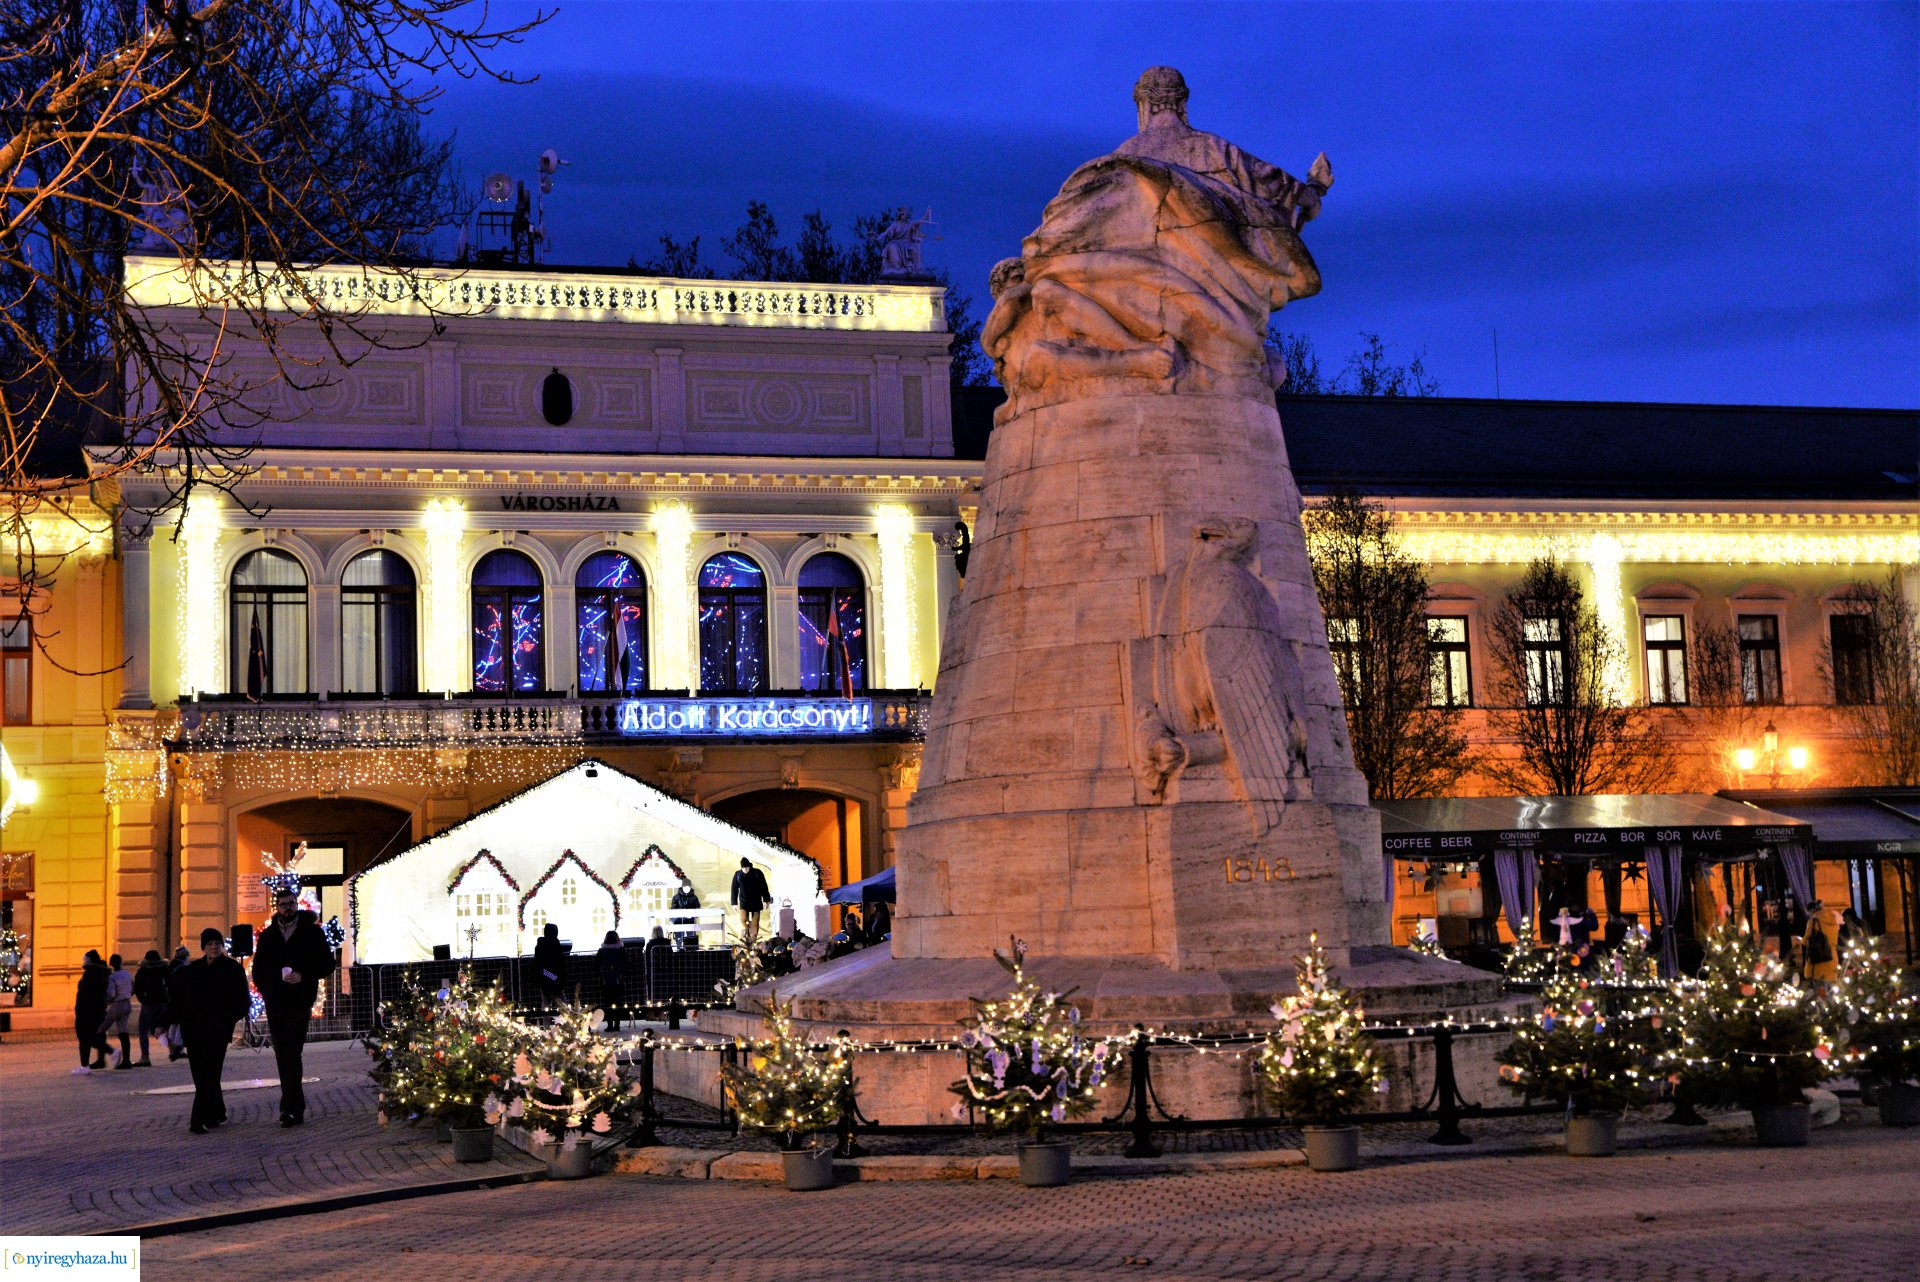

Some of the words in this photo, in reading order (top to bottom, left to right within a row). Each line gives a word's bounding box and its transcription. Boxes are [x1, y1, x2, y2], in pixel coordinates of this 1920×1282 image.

[501, 491, 620, 511] VÁROSHÁZA
[622, 701, 705, 730] Áldott
[718, 701, 869, 732] Karácsonyt!
[1500, 831, 1541, 841] CONTINENT
[1574, 833, 1607, 843] PIZZA
[1620, 832, 1646, 842] BOR
[1656, 830, 1682, 841] SÖR
[1692, 828, 1722, 841] KÁVÉ
[1755, 827, 1795, 836] CONTINENT
[1385, 838, 1432, 849] COFFEE
[1440, 837, 1473, 848] BEER
[1225, 856, 1296, 884] 1848
